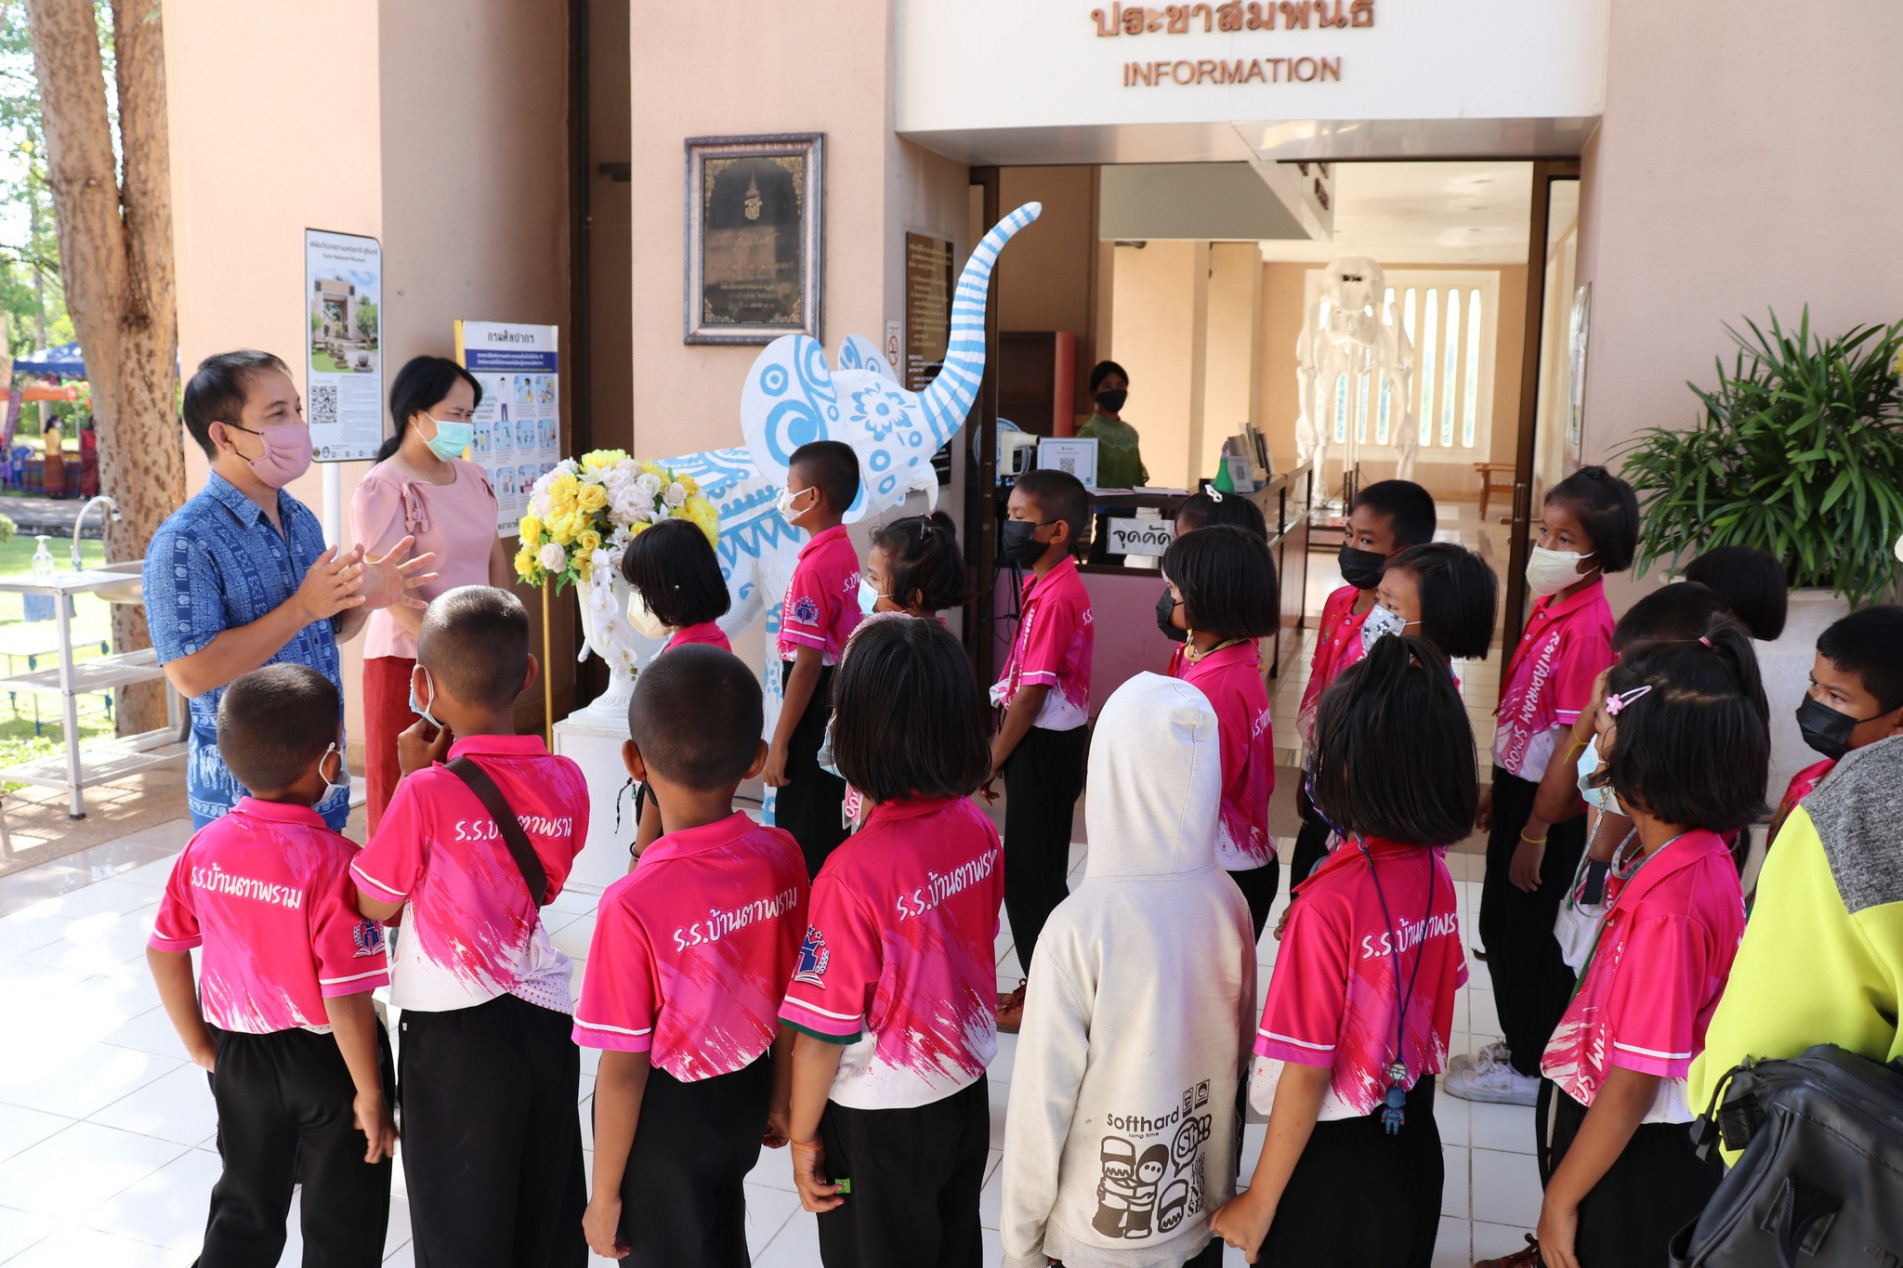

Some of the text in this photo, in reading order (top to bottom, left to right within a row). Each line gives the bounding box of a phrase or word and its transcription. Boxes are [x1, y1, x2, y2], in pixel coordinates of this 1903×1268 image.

[1123, 56, 1341, 87] INFORMATION
[1112, 524, 1172, 549] จุดคัด
[191, 861, 303, 910] ร.ร.บ้านตาพราม
[673, 885, 798, 953] ร.ร.บ้านตาพราม
[1106, 1105, 1180, 1133] softhard
[1175, 1113, 1213, 1159] Sh!!
